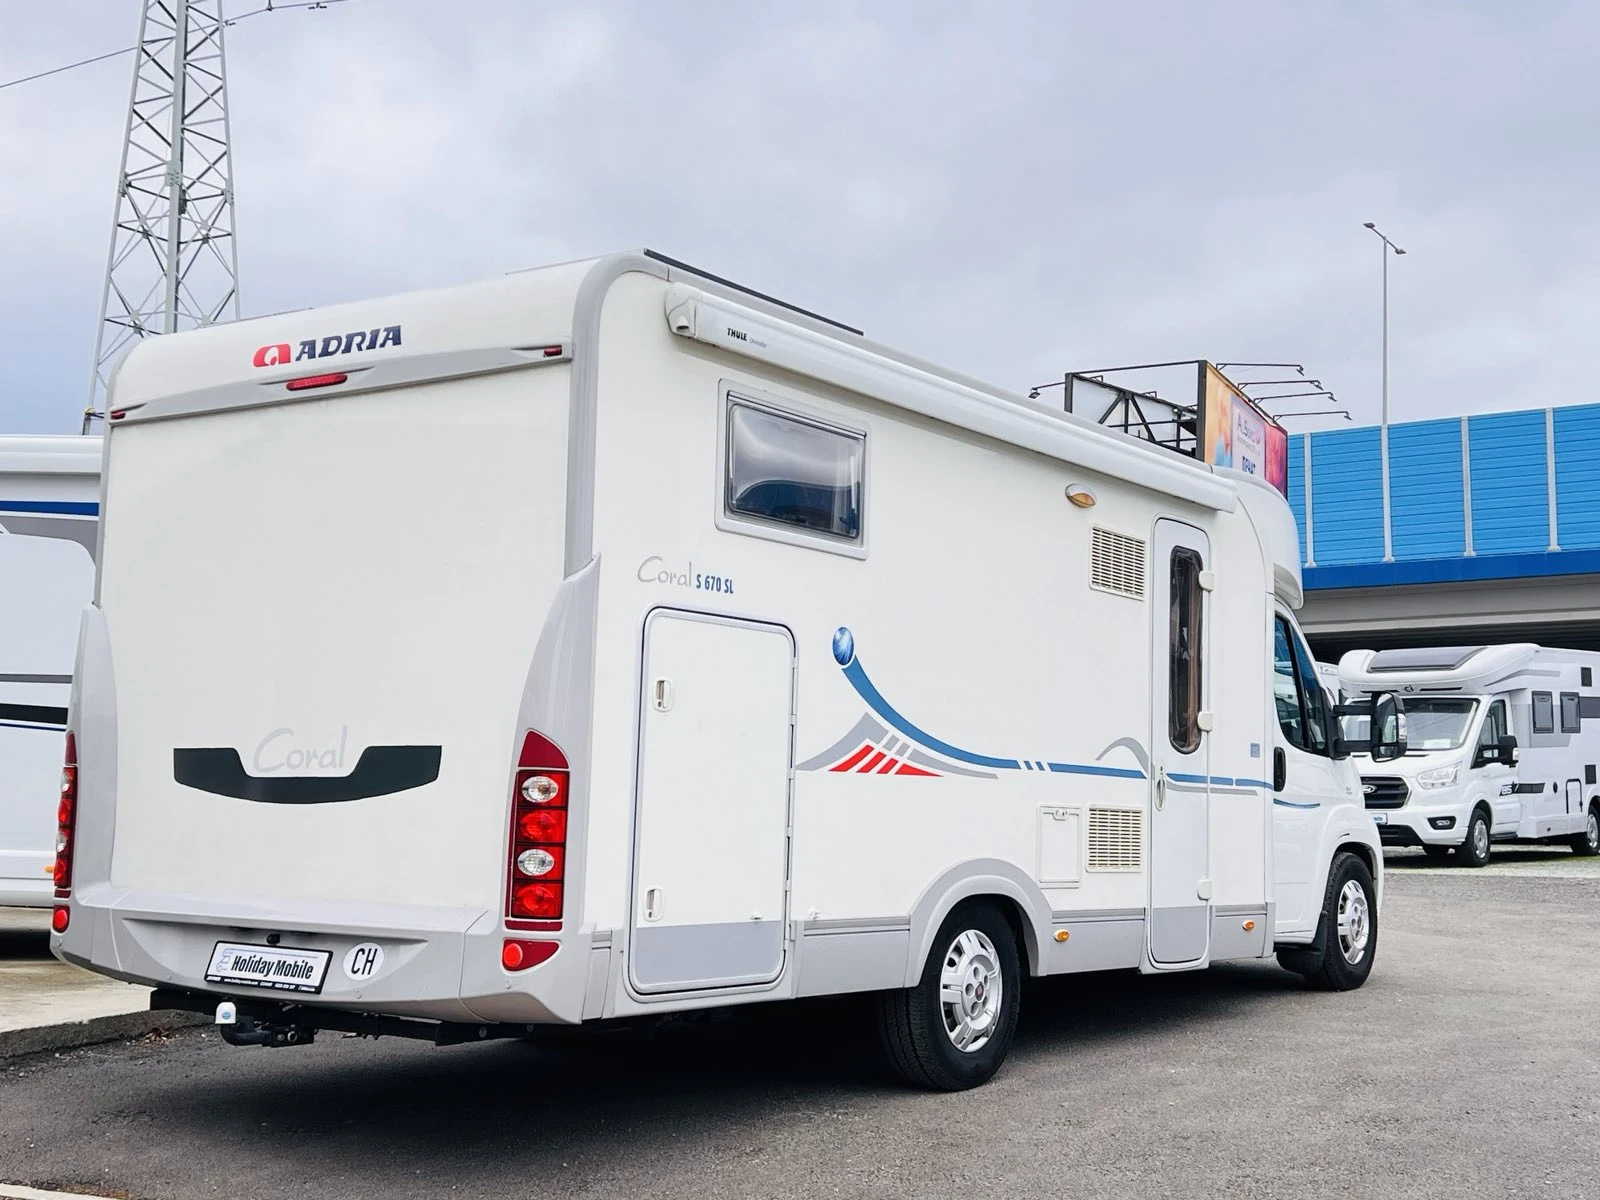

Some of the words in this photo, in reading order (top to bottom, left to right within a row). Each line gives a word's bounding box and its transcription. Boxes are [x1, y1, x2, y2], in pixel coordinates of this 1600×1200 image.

[295, 324, 402, 362] ADRIA
[727, 327, 747, 342] THULE
[637, 555, 692, 587] Coral
[695, 573, 702, 589] S
[704, 575, 722, 592] 670
[724, 578, 734, 594] SL
[253, 724, 348, 773] Coral
[231, 954, 275, 978] Holiday
[273, 959, 314, 980] Mobile
[353, 947, 374, 976] CH
